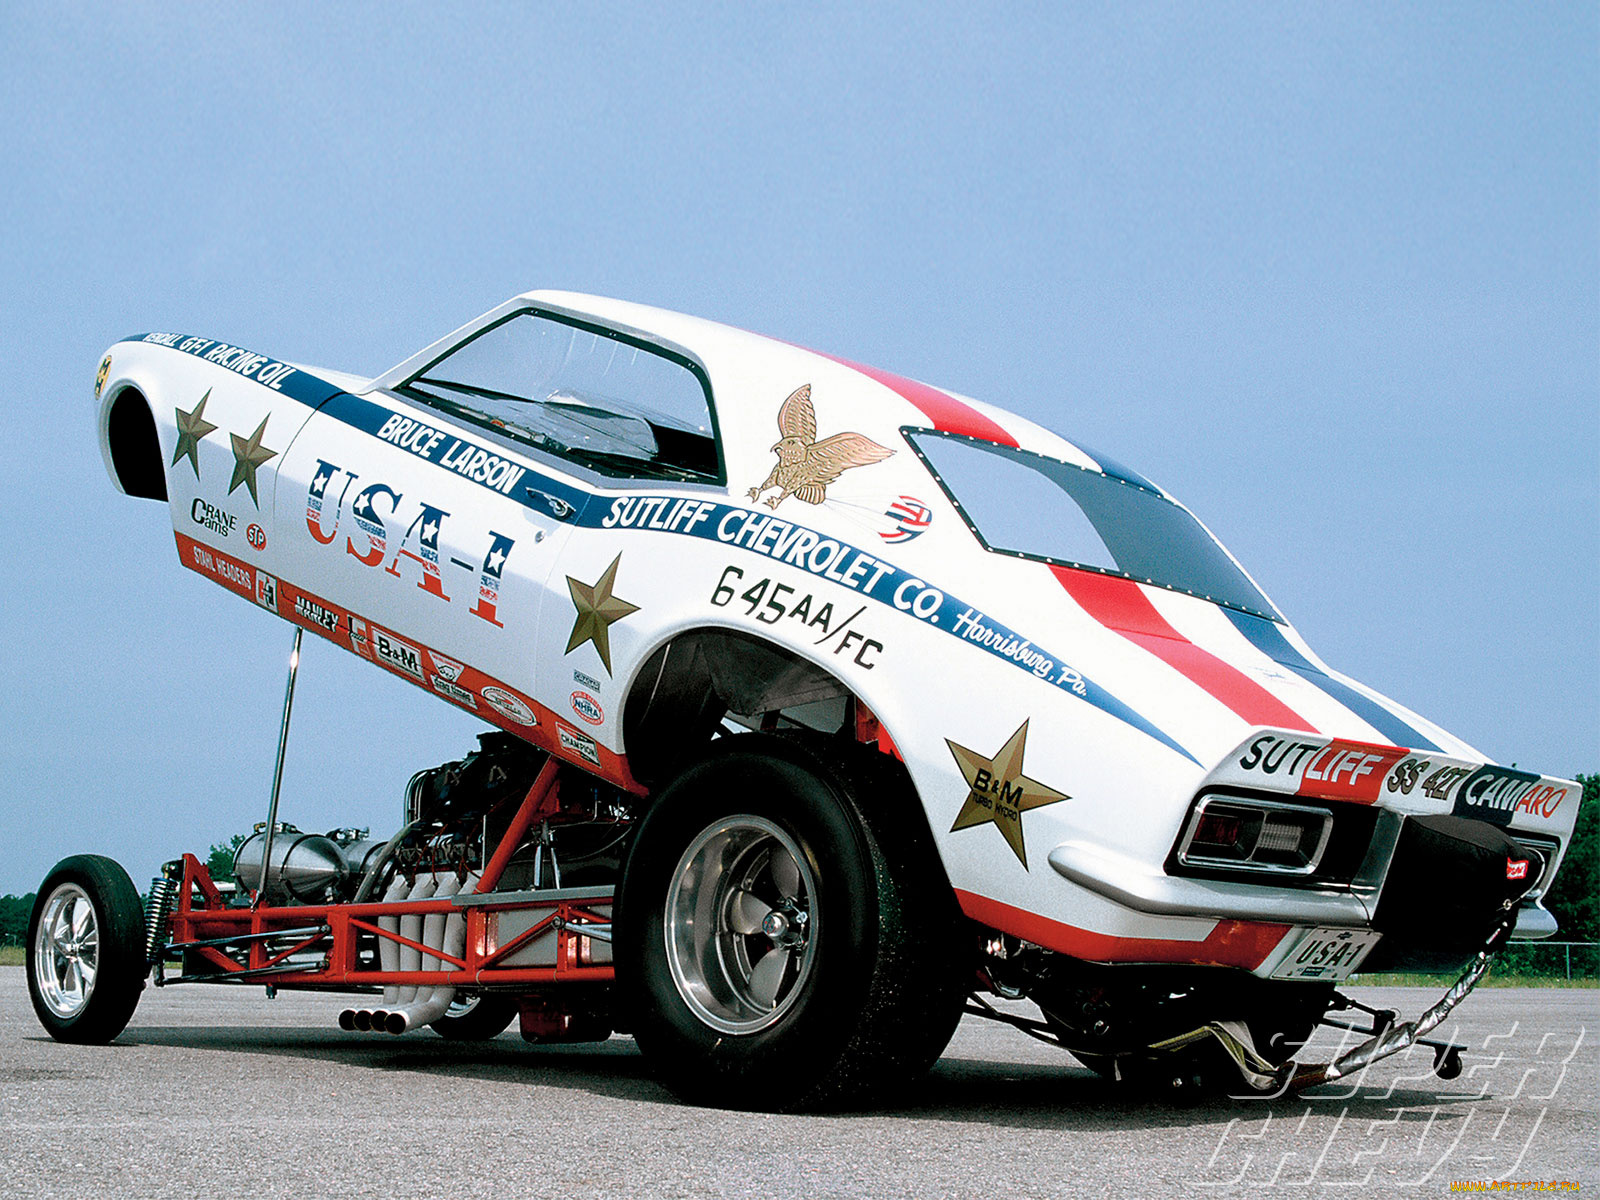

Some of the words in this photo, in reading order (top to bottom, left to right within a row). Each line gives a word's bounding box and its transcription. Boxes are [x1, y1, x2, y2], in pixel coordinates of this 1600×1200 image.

[203, 344, 269, 376] RACING
[257, 363, 297, 390] OIL
[377, 413, 447, 458] BRUCE
[439, 440, 526, 494] LARSON
[248, 525, 265, 547] STP
[602, 496, 716, 533] SUTLIFF
[716, 509, 896, 594] CHEVROLET
[893, 578, 944, 623] CO.
[952, 608, 1055, 681] Harrisburg,
[1056, 666, 1088, 697] Pa.
[574, 699, 600, 718] NHRA
[561, 733, 598, 758] CHAMPION
[1239, 735, 1385, 786] SUTLIFF
[1387, 758, 1431, 795] SS
[1421, 765, 1473, 801] 427
[1466, 772, 1567, 819] CAMARO
[972, 792, 993, 810] TURBO
